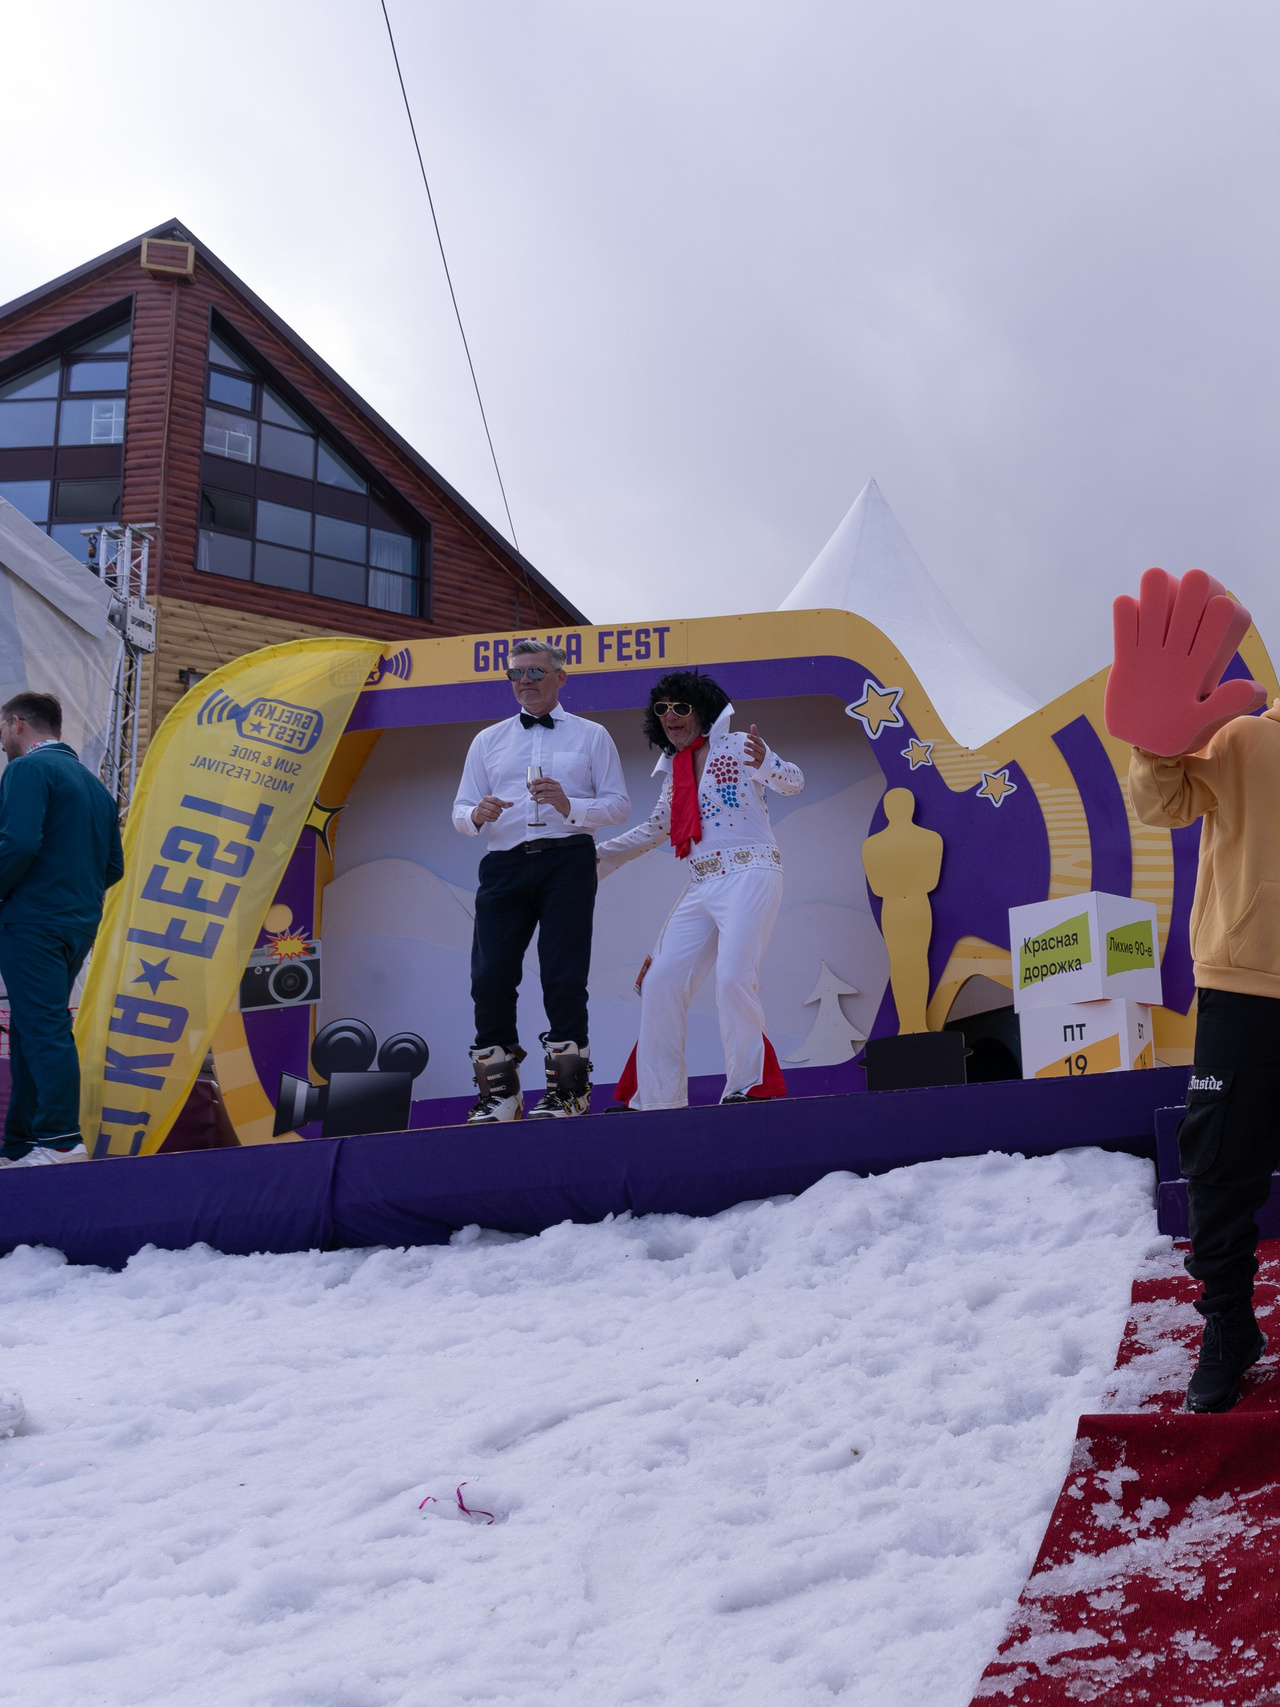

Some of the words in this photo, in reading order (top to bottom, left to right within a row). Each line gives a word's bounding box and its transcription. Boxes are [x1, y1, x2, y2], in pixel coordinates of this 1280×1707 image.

[474, 633, 582, 672] GRA
[598, 627, 670, 663] FEST
[1023, 932, 1078, 958] Красная
[1109, 937, 1133, 955] Лихие
[1135, 941, 1153, 957] 90-е
[1023, 958, 1082, 983] дорожка
[1063, 1023, 1086, 1042] ПТ
[1064, 1054, 1088, 1076] 19
